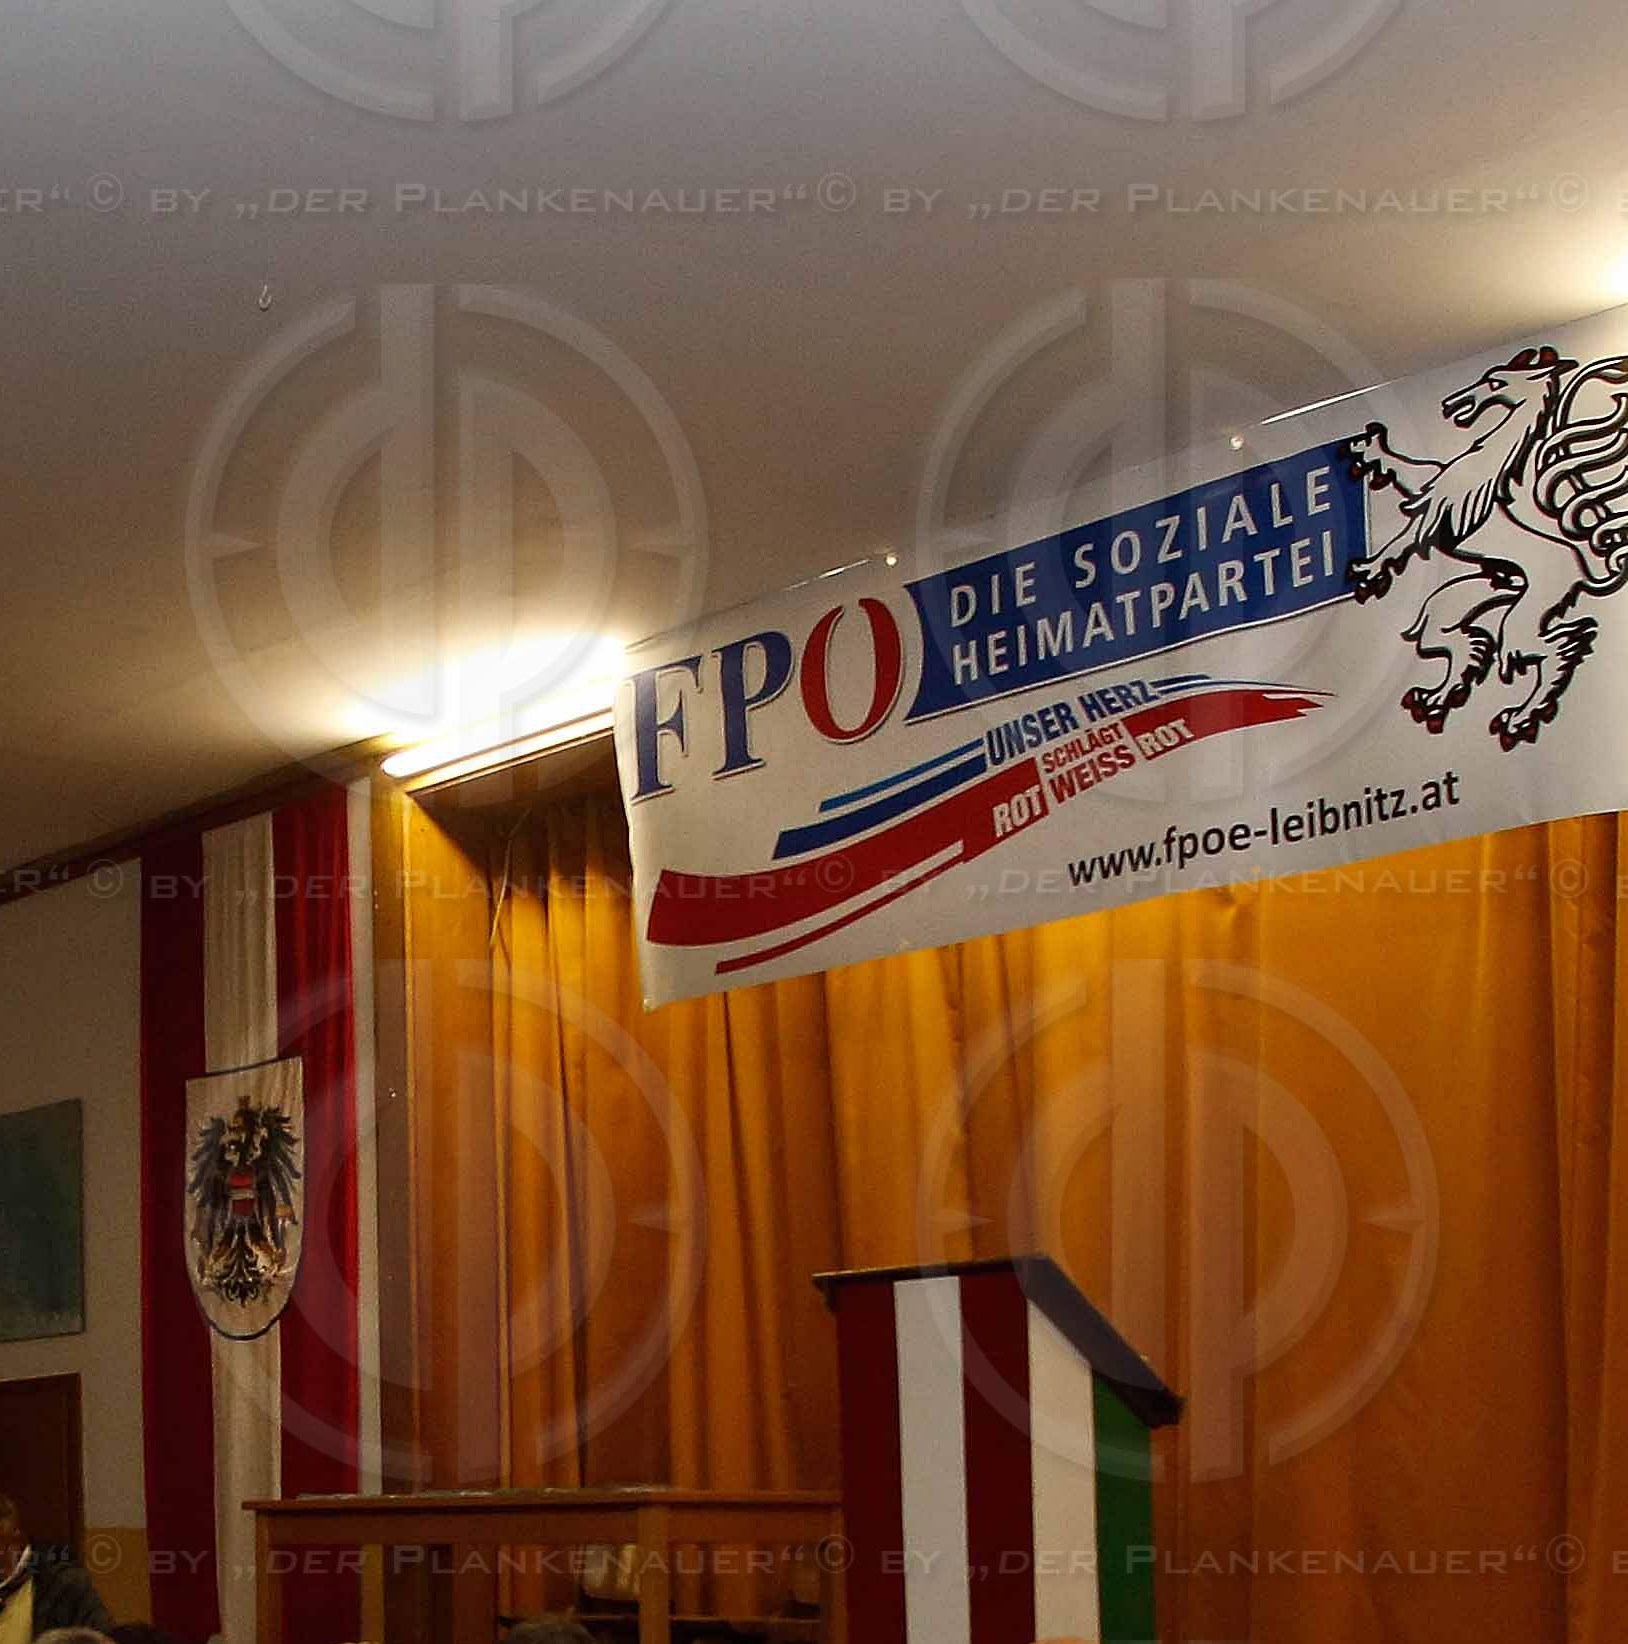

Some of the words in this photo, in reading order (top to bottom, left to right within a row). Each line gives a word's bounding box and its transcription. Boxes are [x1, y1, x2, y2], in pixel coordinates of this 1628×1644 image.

[950, 561, 1037, 629] DIE
[1074, 465, 1333, 589] SOZIALE
[951, 530, 1334, 687] HEIMATPARTEI
[986, 702, 1080, 766] UNSER
[1078, 680, 1159, 722] HERZ
[992, 785, 1044, 837] ROT
[1048, 745, 1136, 803] WEISS
[1135, 718, 1194, 758] ROT
[1042, 723, 1124, 773] SCHLÄGT
[1068, 771, 1460, 888] www.fpoe-leibnitz.at
